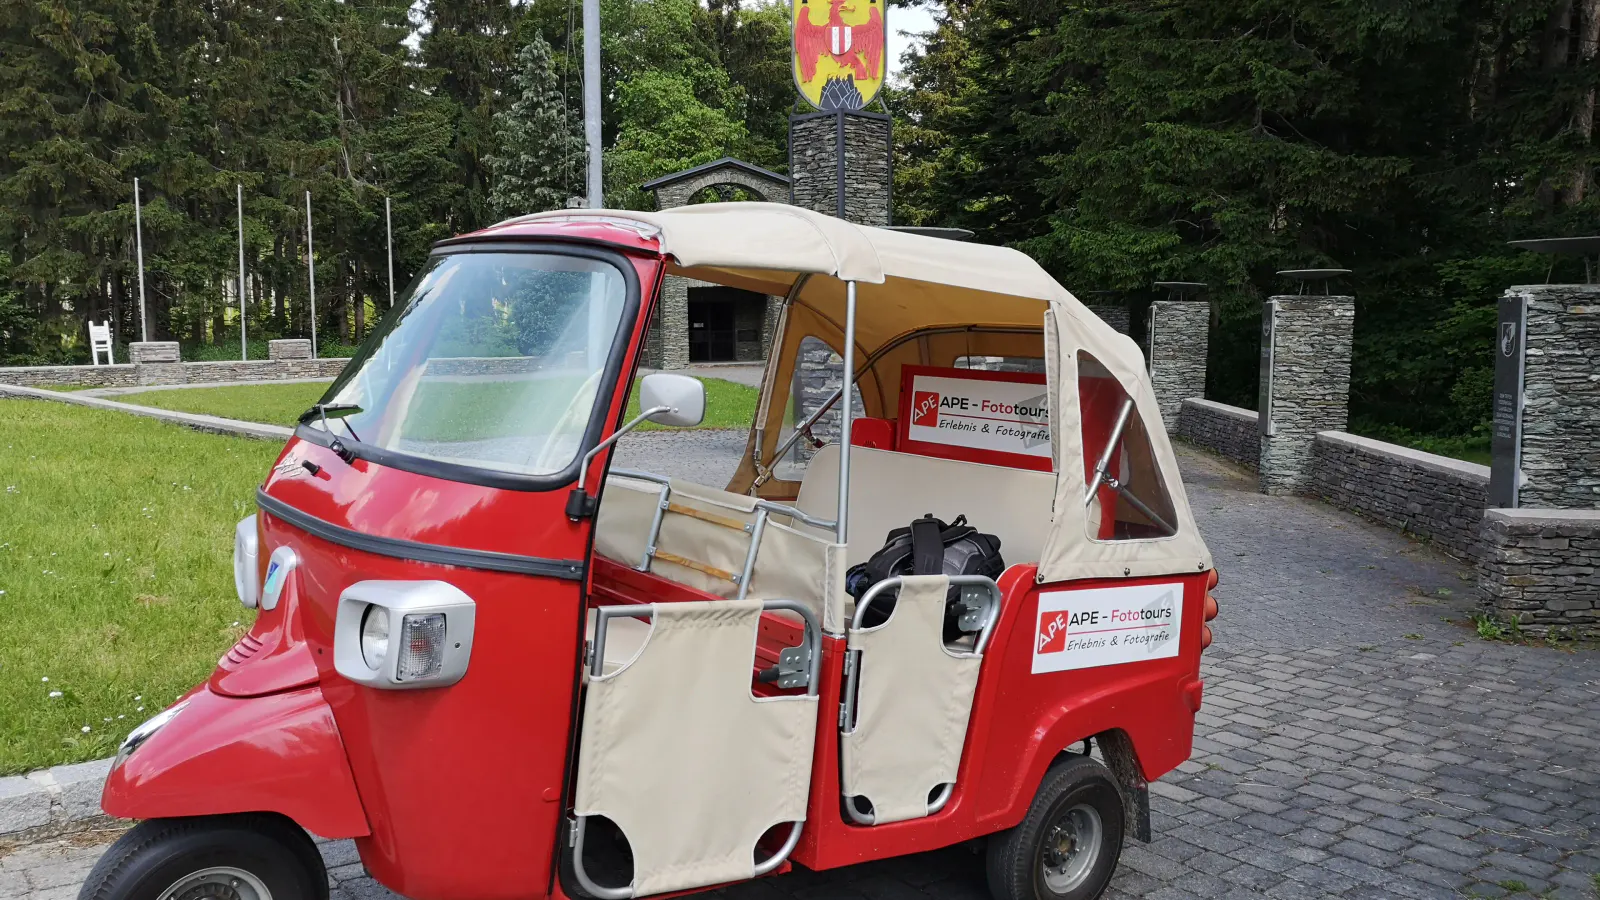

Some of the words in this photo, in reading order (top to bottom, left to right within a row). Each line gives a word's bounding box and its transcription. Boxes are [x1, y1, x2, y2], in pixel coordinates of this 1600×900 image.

[914, 395, 937, 422] APE
[940, 396, 969, 410] APE
[939, 420, 977, 432] Erlebnis
[981, 423, 990, 433] &
[996, 425, 1050, 441] Fotografie
[1069, 611, 1099, 626] APE
[1111, 607, 1172, 623] Fototours
[1038, 613, 1066, 651] APE
[1067, 637, 1106, 651] Erlebnis
[1110, 635, 1118, 646] &
[1123, 631, 1170, 645] Fotografie
